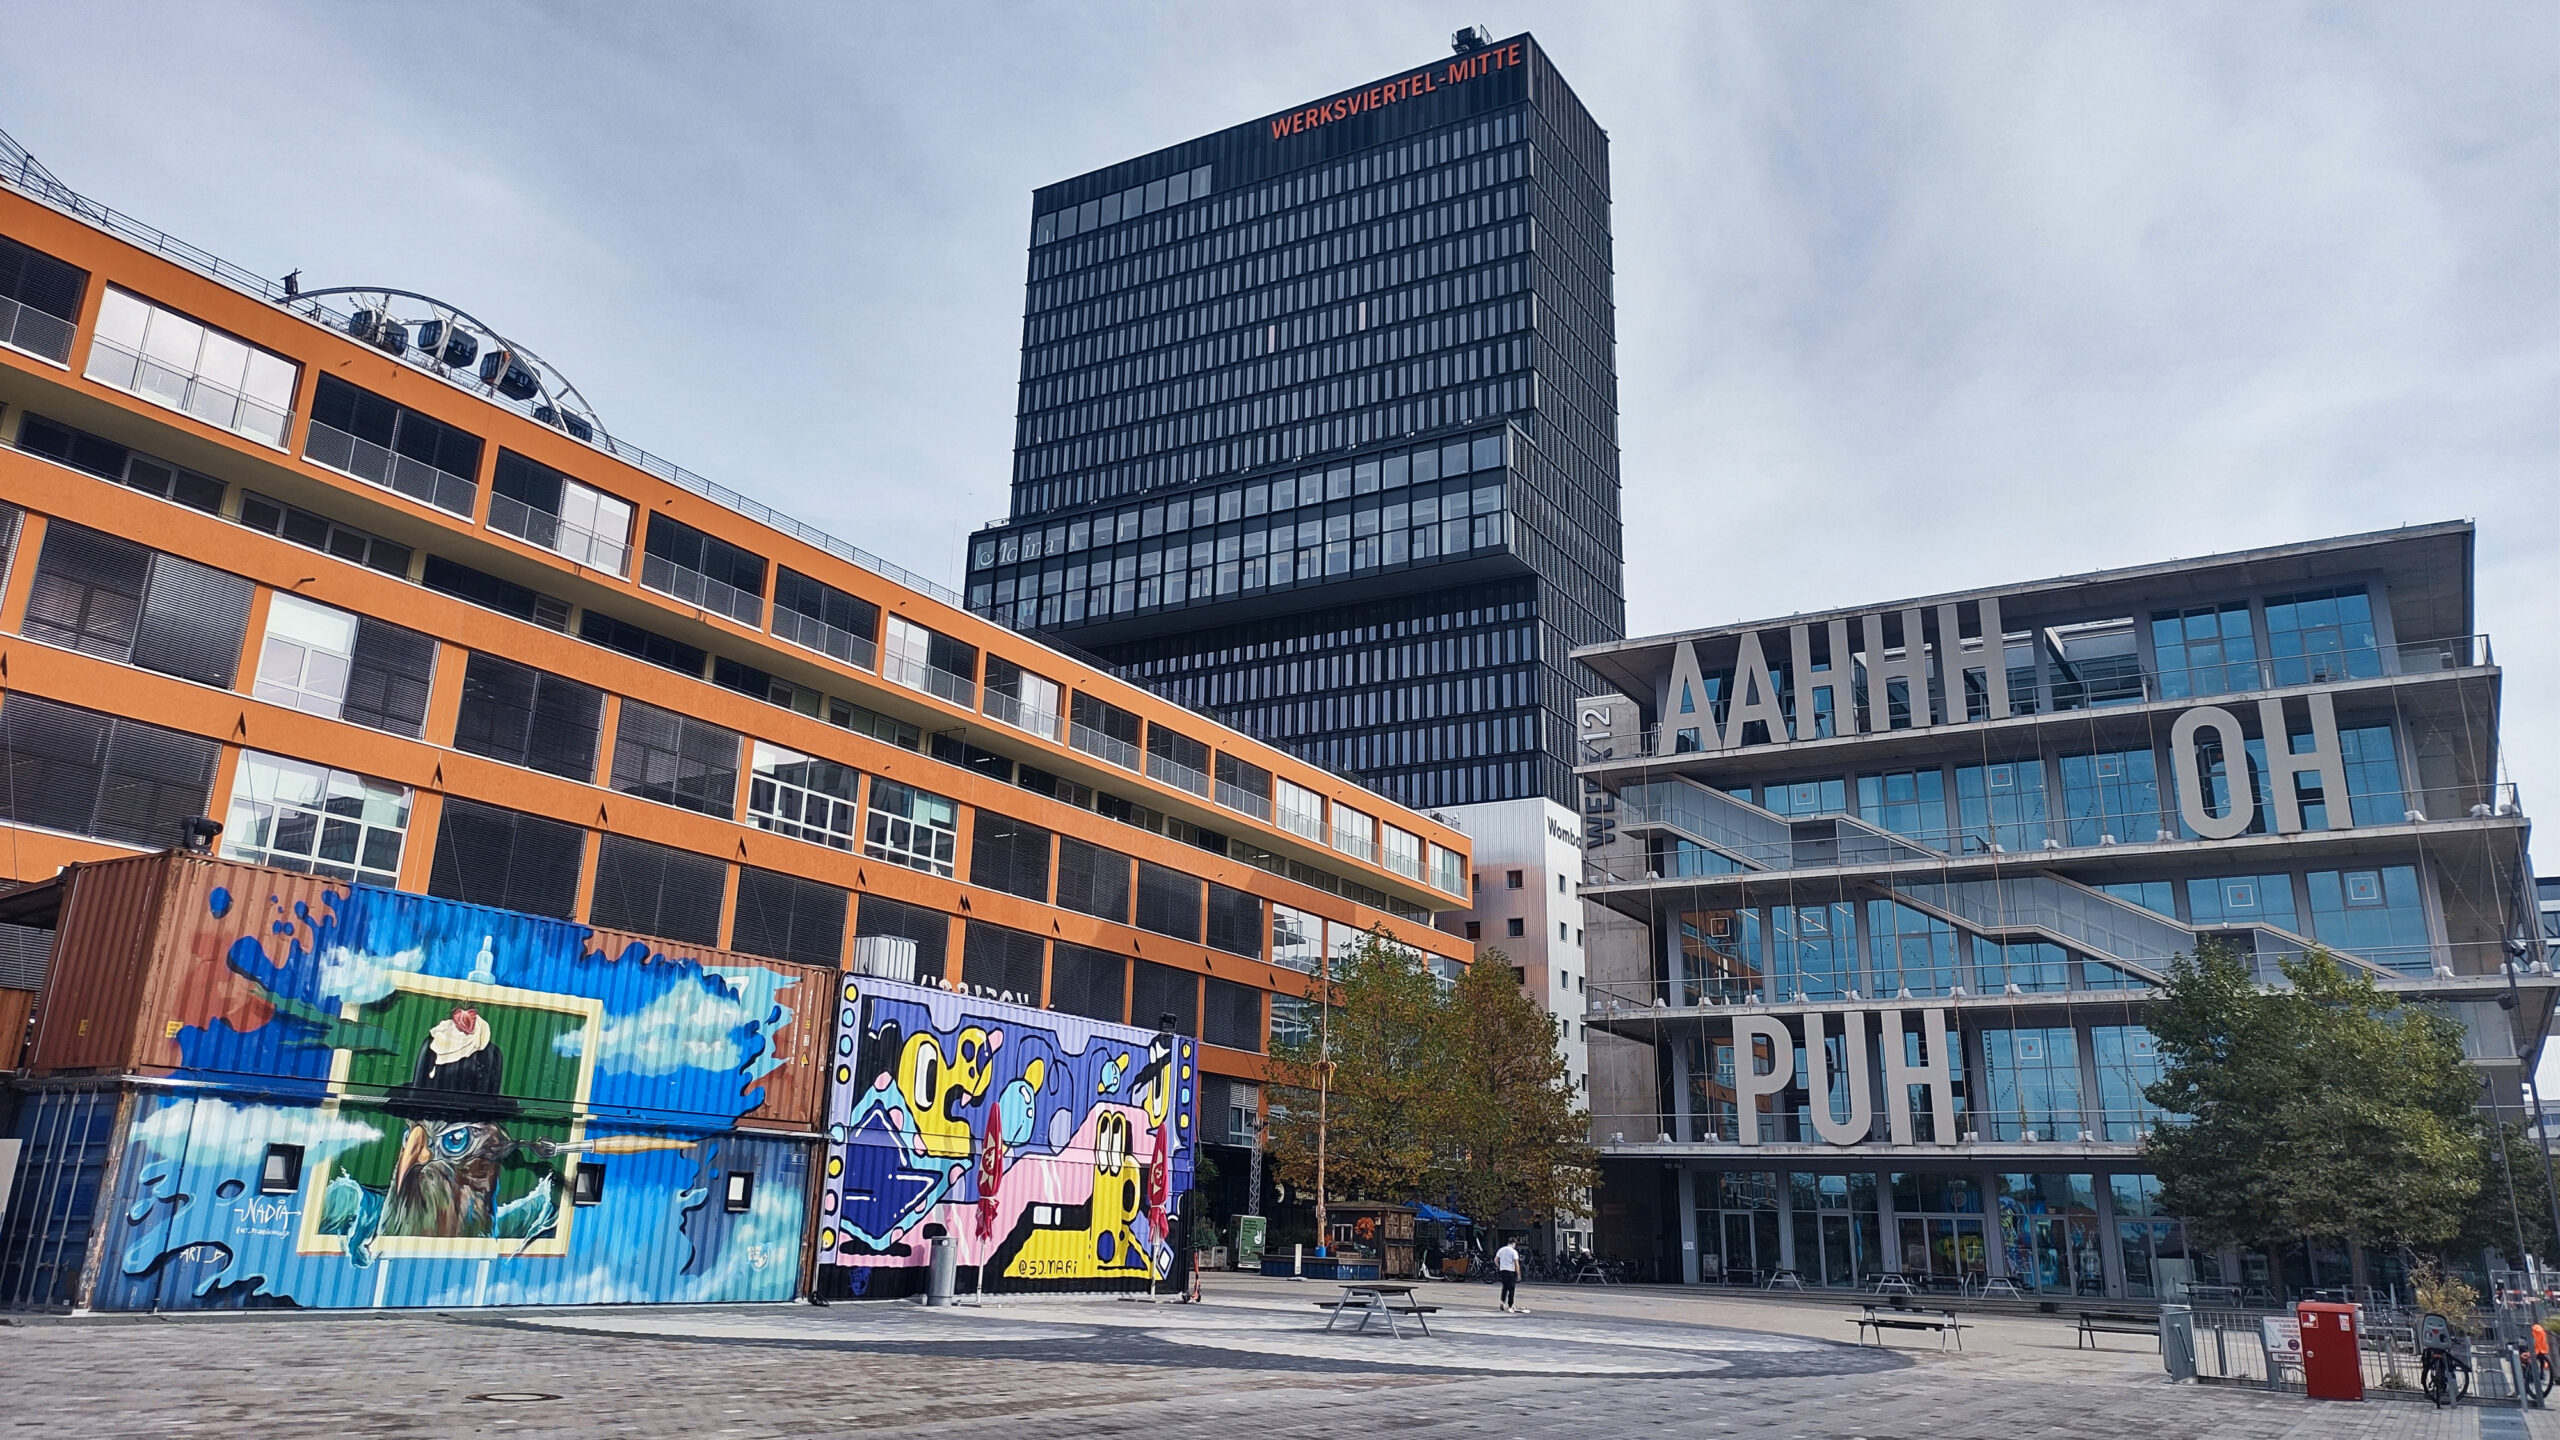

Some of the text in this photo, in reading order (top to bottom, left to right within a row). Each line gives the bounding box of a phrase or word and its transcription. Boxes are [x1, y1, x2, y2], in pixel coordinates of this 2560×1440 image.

[1271, 43, 1521, 139] WERKSVIERTEL-MITTE
[1659, 600, 2011, 756] AAHHH
[2170, 693, 2354, 840] OH
[1732, 1008, 1957, 1146] PUH
